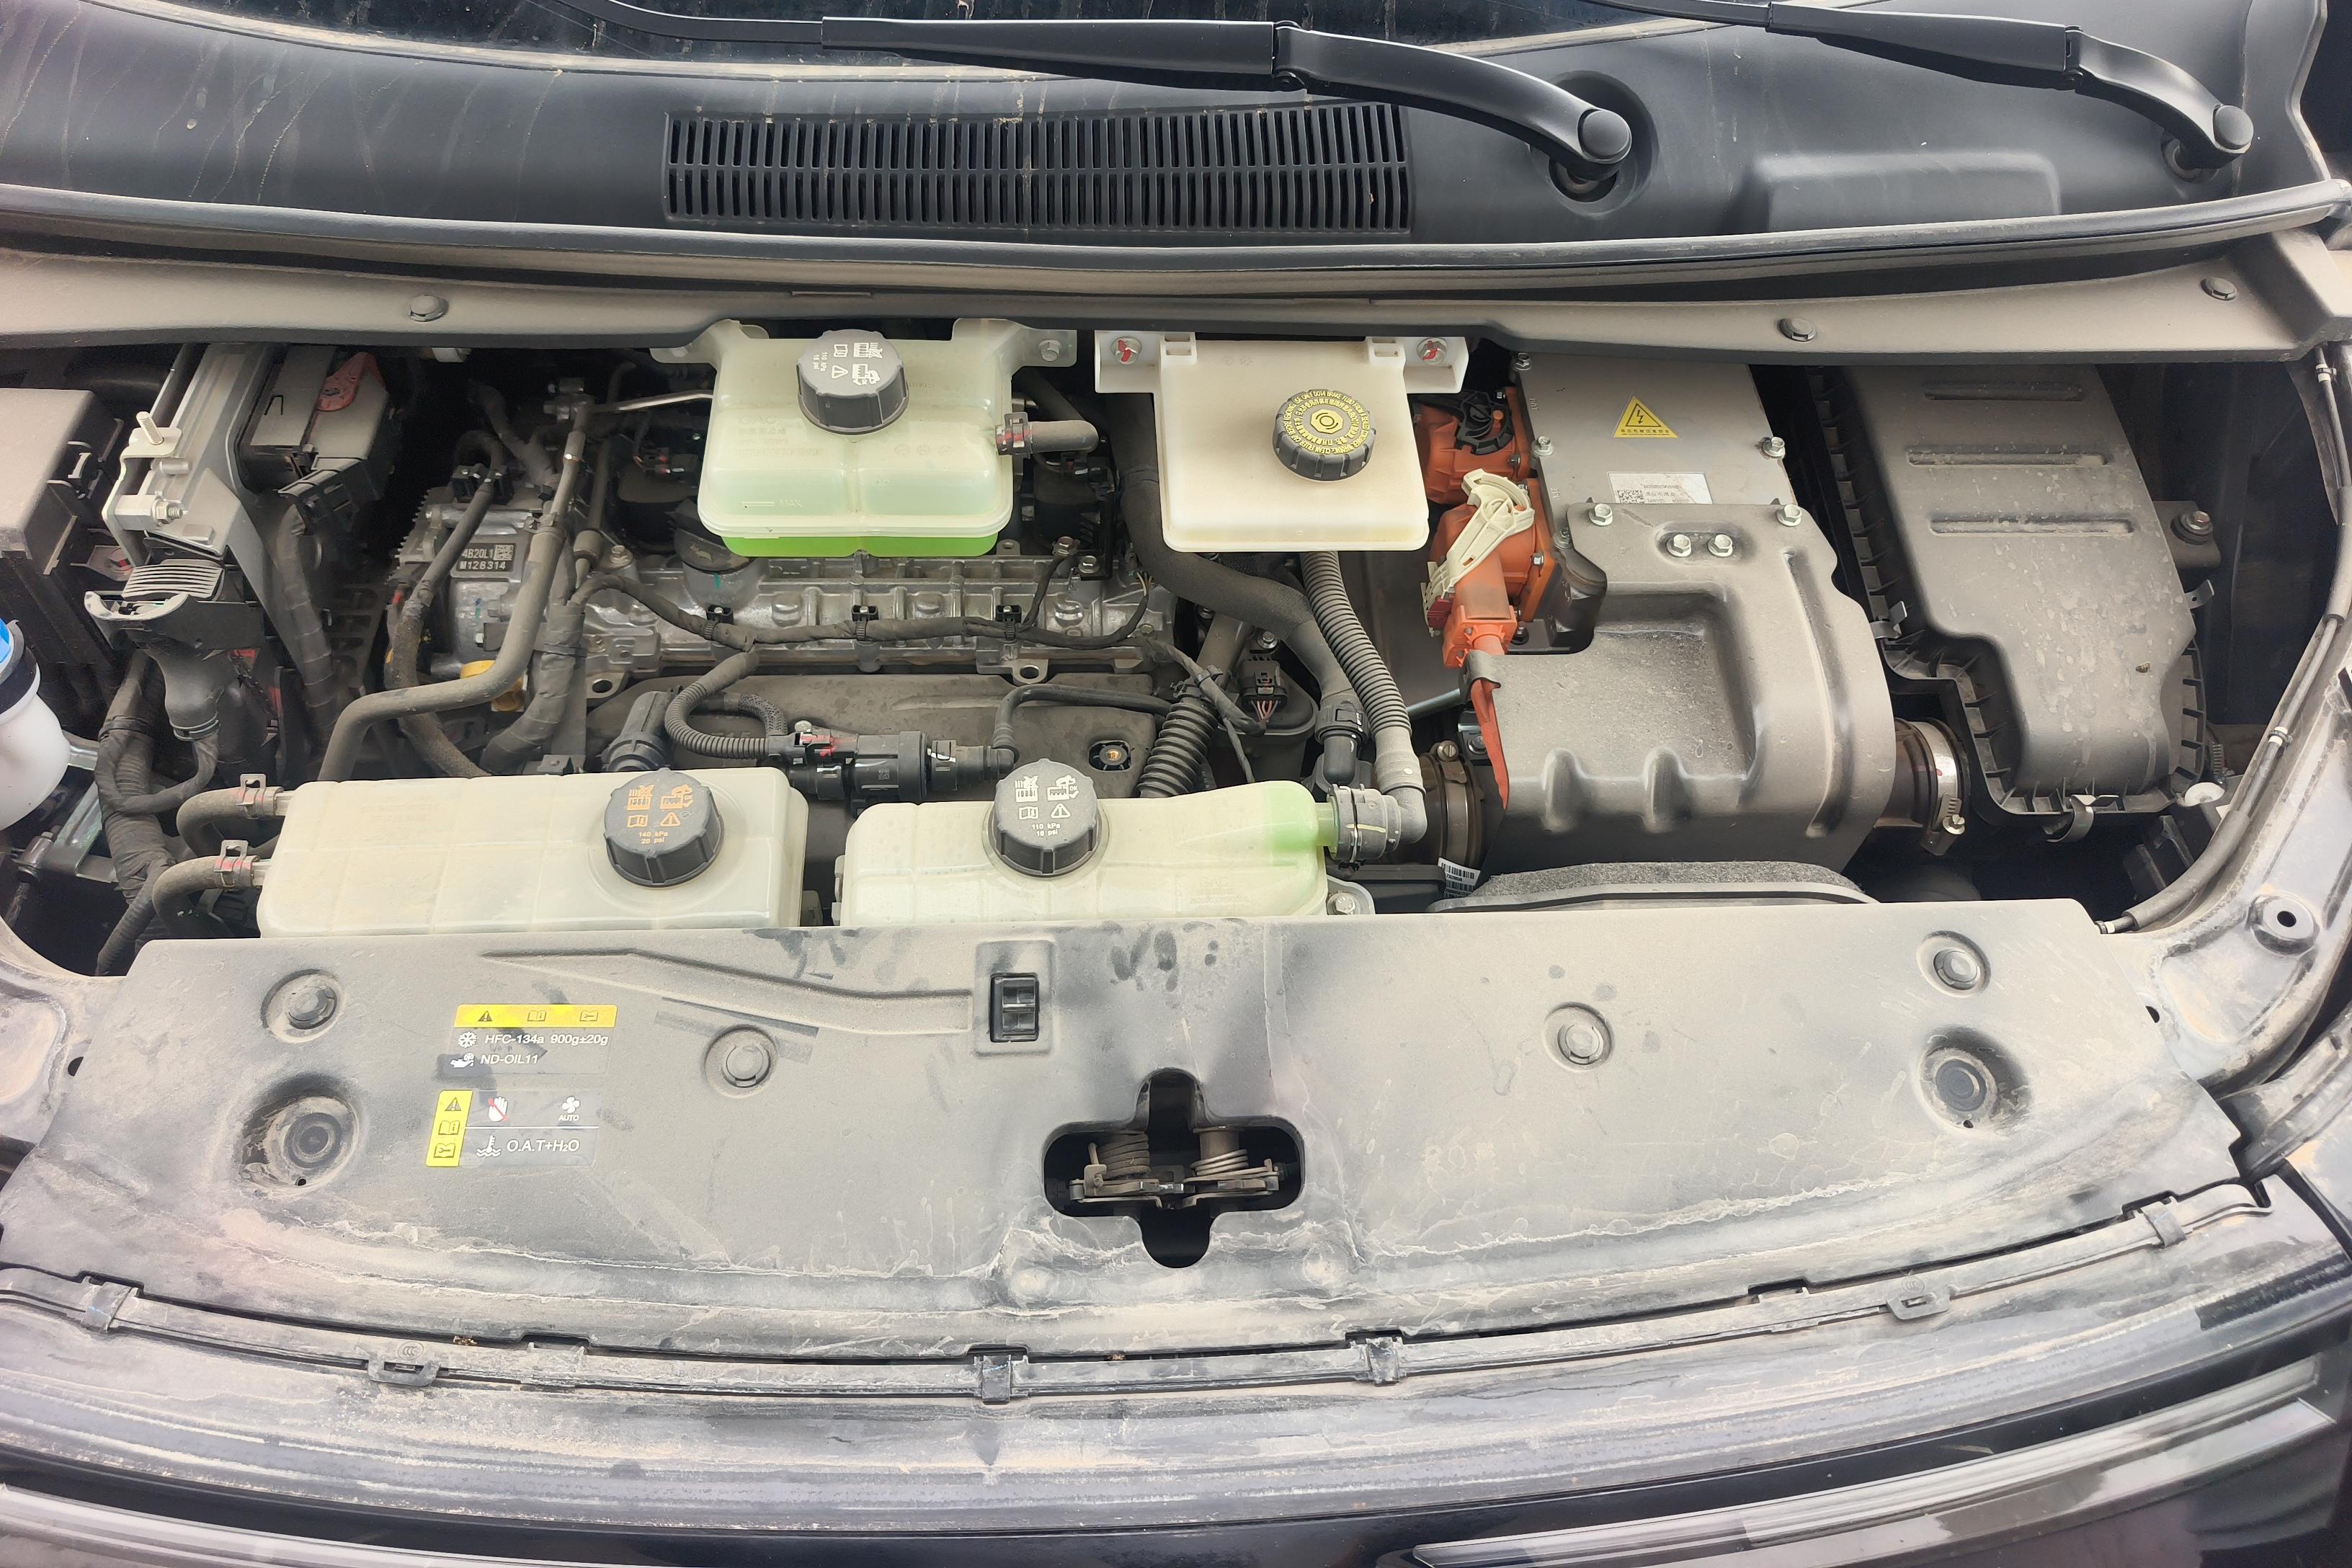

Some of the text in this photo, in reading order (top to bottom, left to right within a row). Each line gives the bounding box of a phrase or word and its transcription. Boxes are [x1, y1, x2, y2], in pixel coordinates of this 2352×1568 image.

[1301, 391, 1313, 400] ONLY
[1327, 391, 1342, 399] BRAKE
[484, 1034, 608, 1046] HFC-134a 900g±20g
[480, 1054, 538, 1064] ND-OIL11
